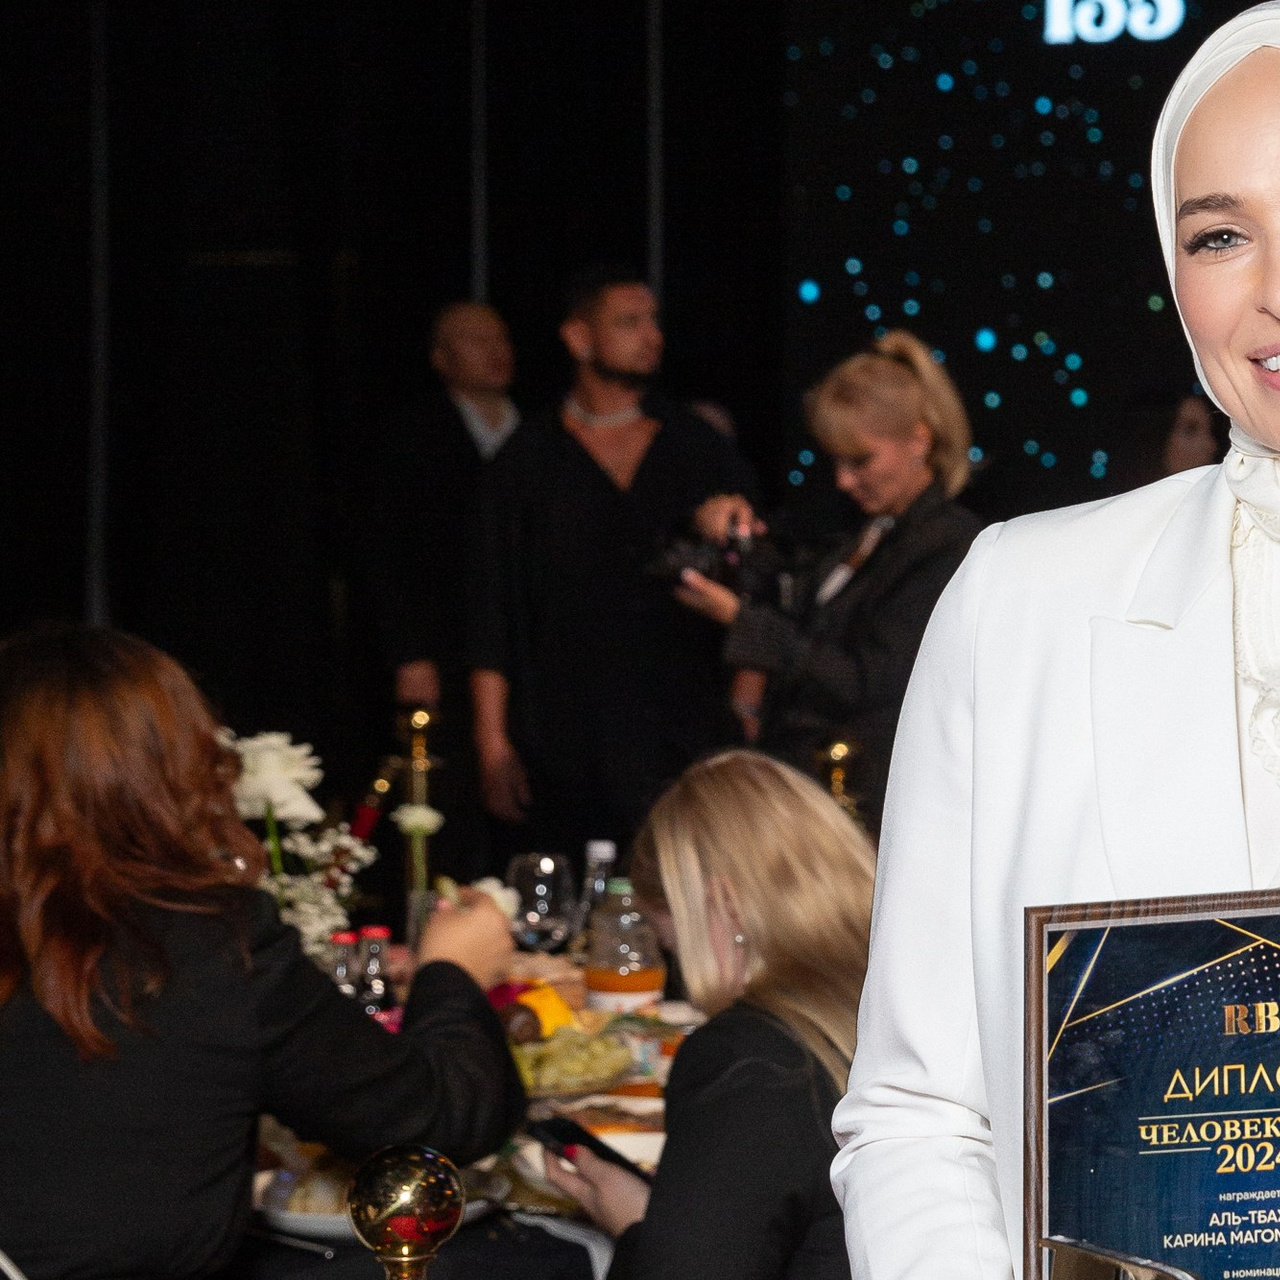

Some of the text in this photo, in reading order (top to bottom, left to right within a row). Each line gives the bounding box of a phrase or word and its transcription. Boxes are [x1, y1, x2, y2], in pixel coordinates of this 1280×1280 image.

[1222, 1001, 1280, 1036] RB
[1163, 1232, 1227, 1249] КАРИНА
[1223, 1270, 1231, 1279] в
